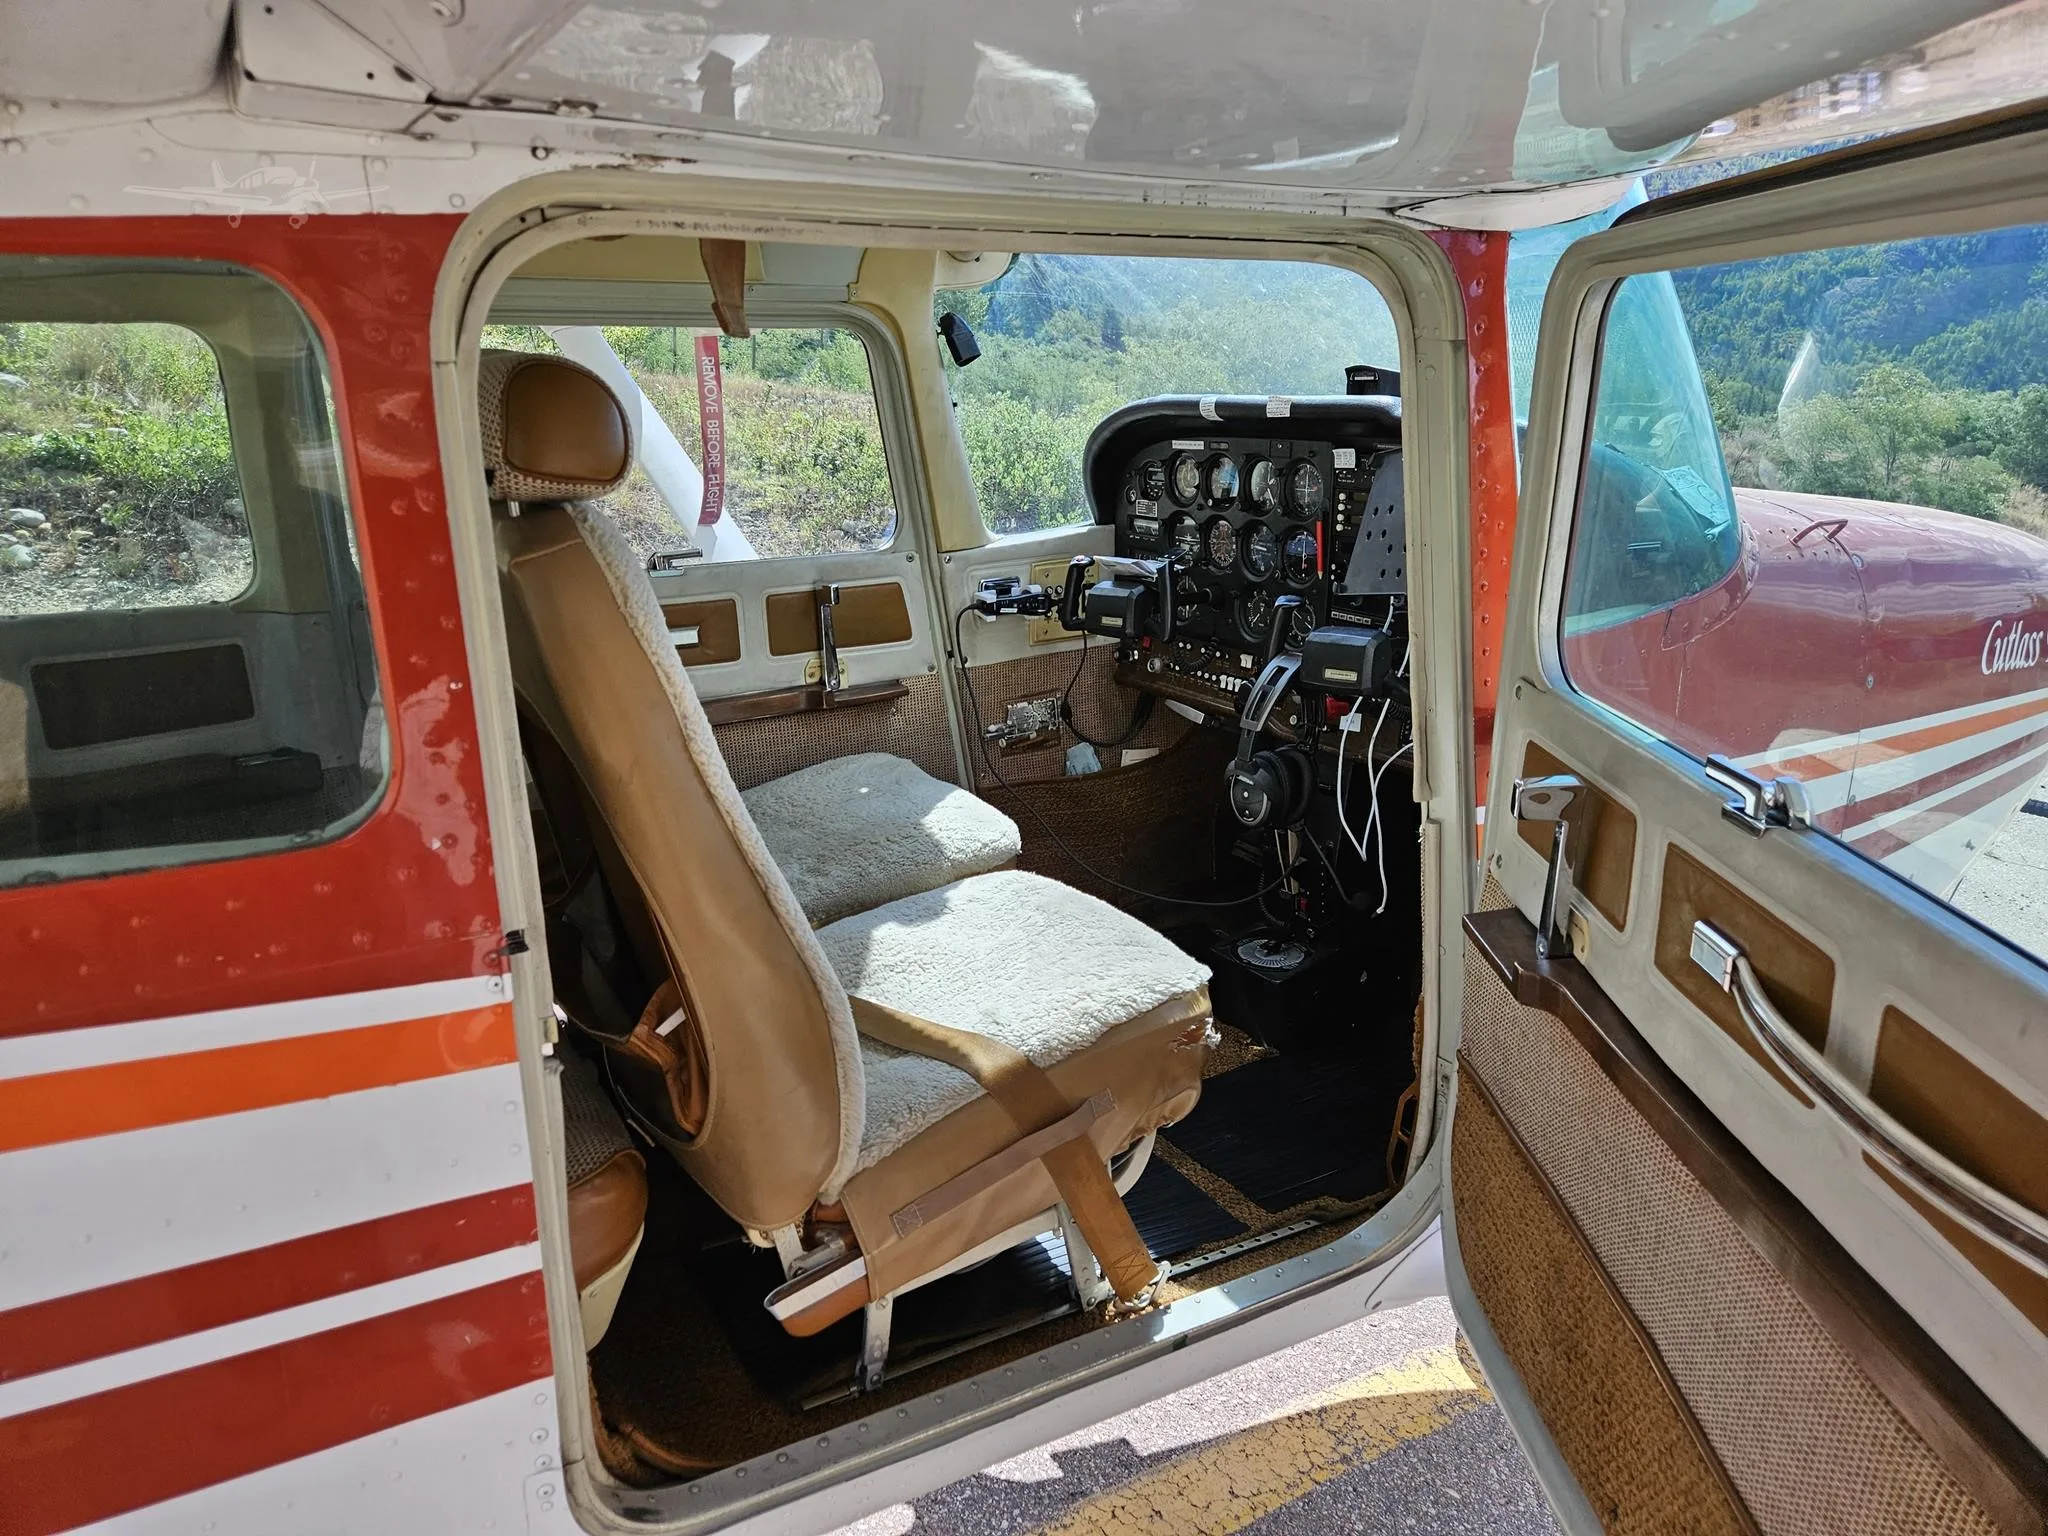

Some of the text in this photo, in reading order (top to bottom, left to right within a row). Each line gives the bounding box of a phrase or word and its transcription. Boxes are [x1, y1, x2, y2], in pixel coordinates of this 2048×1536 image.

[702, 356, 722, 513] REMOVE BEFORE FLIGHT
[1981, 619, 2044, 675] Cutlass
